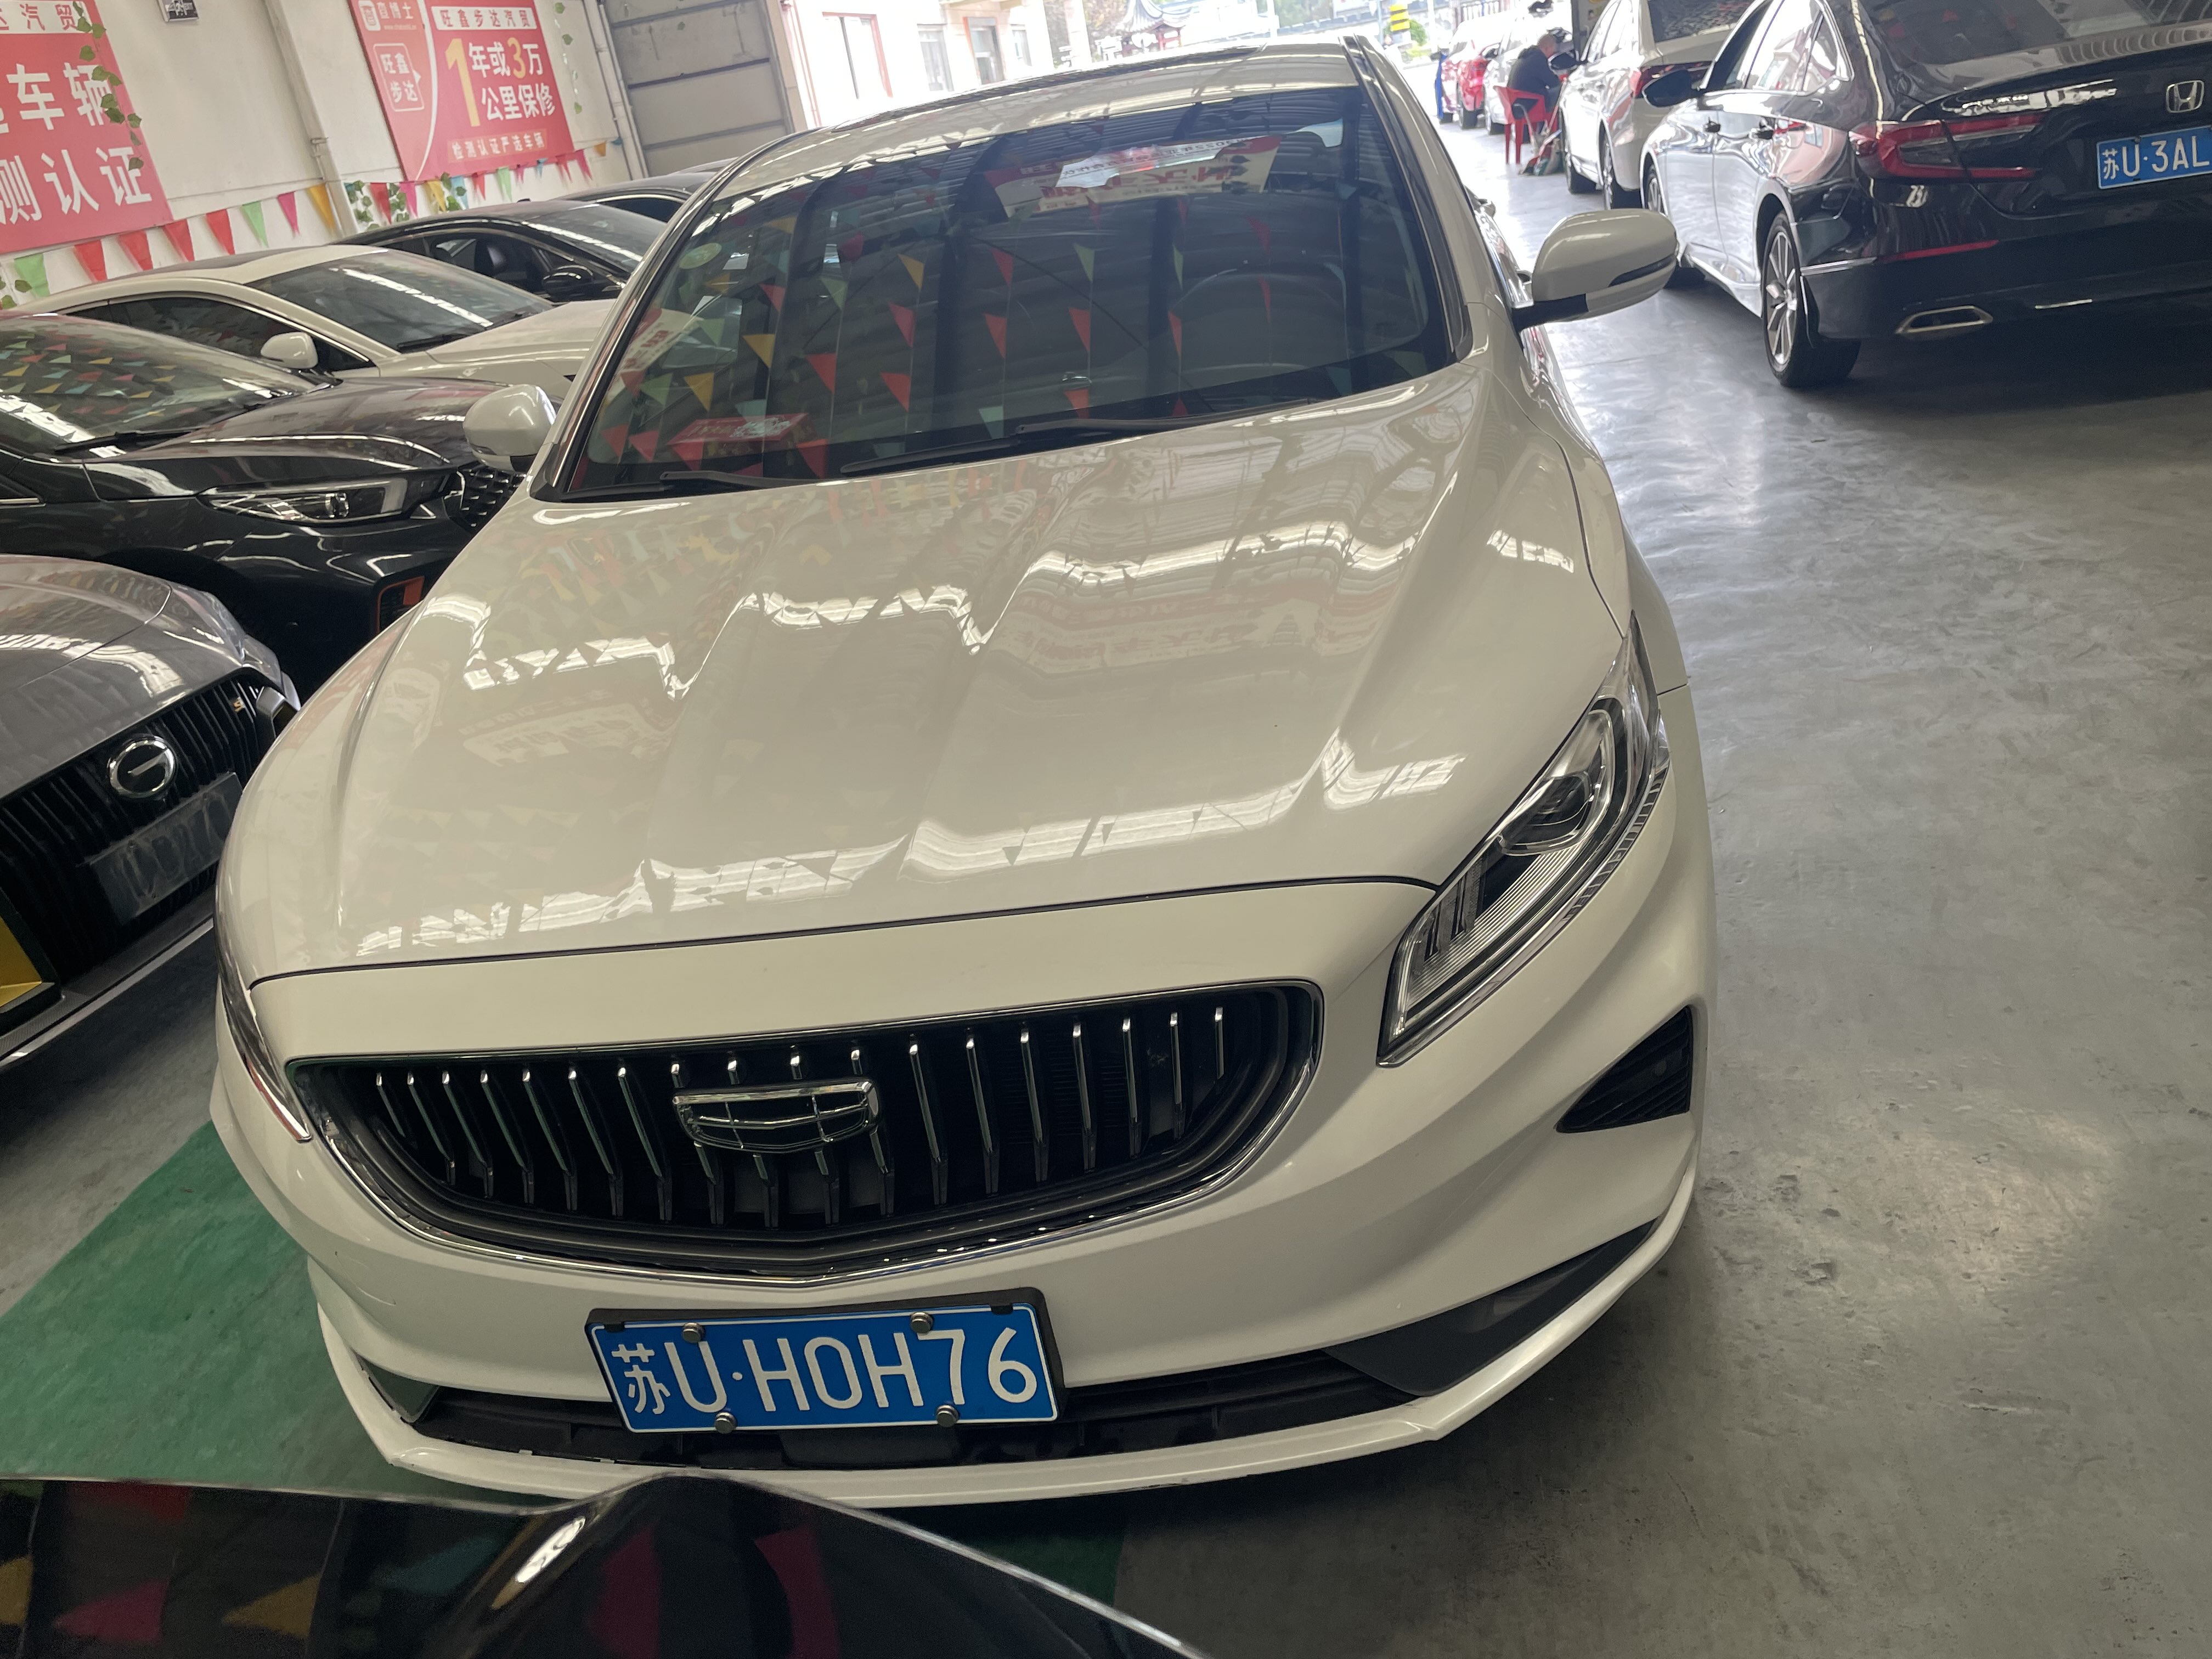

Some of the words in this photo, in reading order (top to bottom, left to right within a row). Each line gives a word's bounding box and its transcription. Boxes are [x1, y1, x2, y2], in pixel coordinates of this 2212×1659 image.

[440, 9, 531, 27] 旺鑫步达汽贸
[0, 62, 112, 134] 车辆
[481, 83, 556, 121] 公里保修
[452, 132, 545, 160] 检测认证严选车辆
